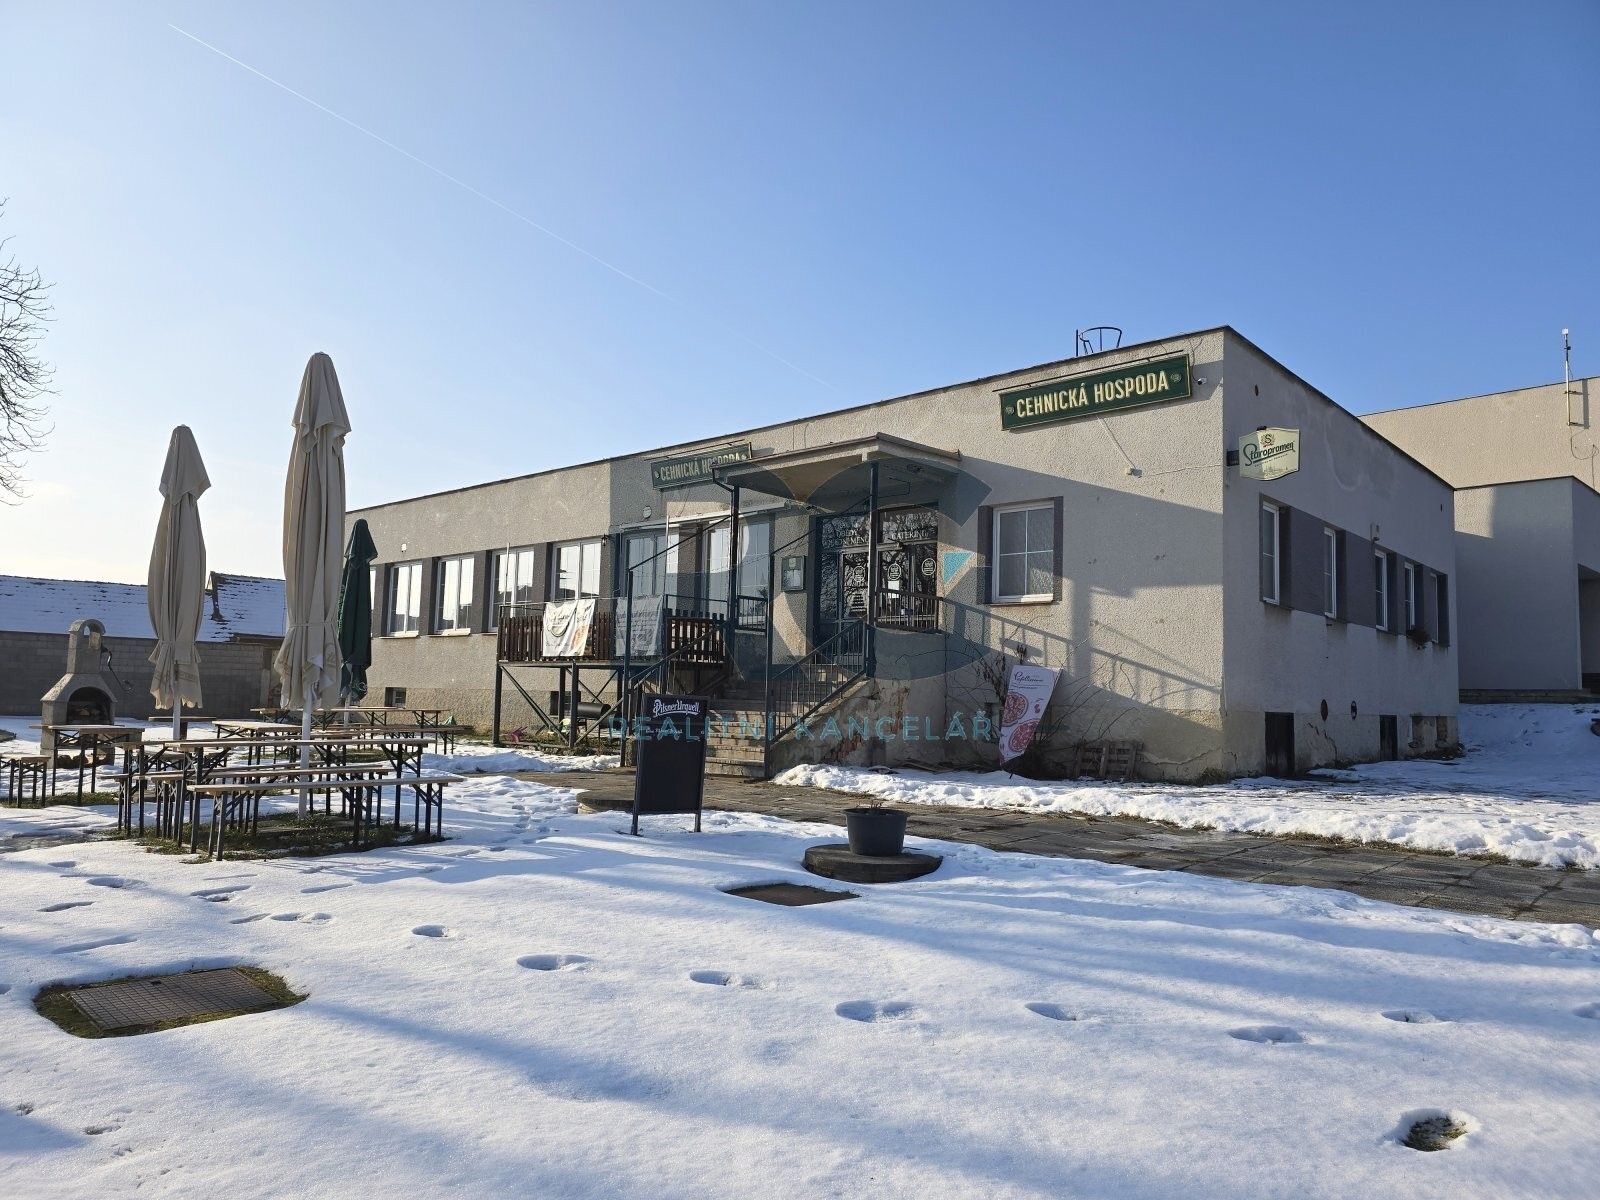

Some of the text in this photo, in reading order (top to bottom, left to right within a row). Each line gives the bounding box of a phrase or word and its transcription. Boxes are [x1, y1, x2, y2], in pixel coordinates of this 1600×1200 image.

[1016, 370, 1169, 418] CEHNICKÁ HOSPODA
[1243, 441, 1295, 466] Staropramen
[660, 458, 700, 481] CEHNICKÁ
[891, 530, 928, 540] CATERING
[653, 698, 700, 717] Pilsner Urquell
